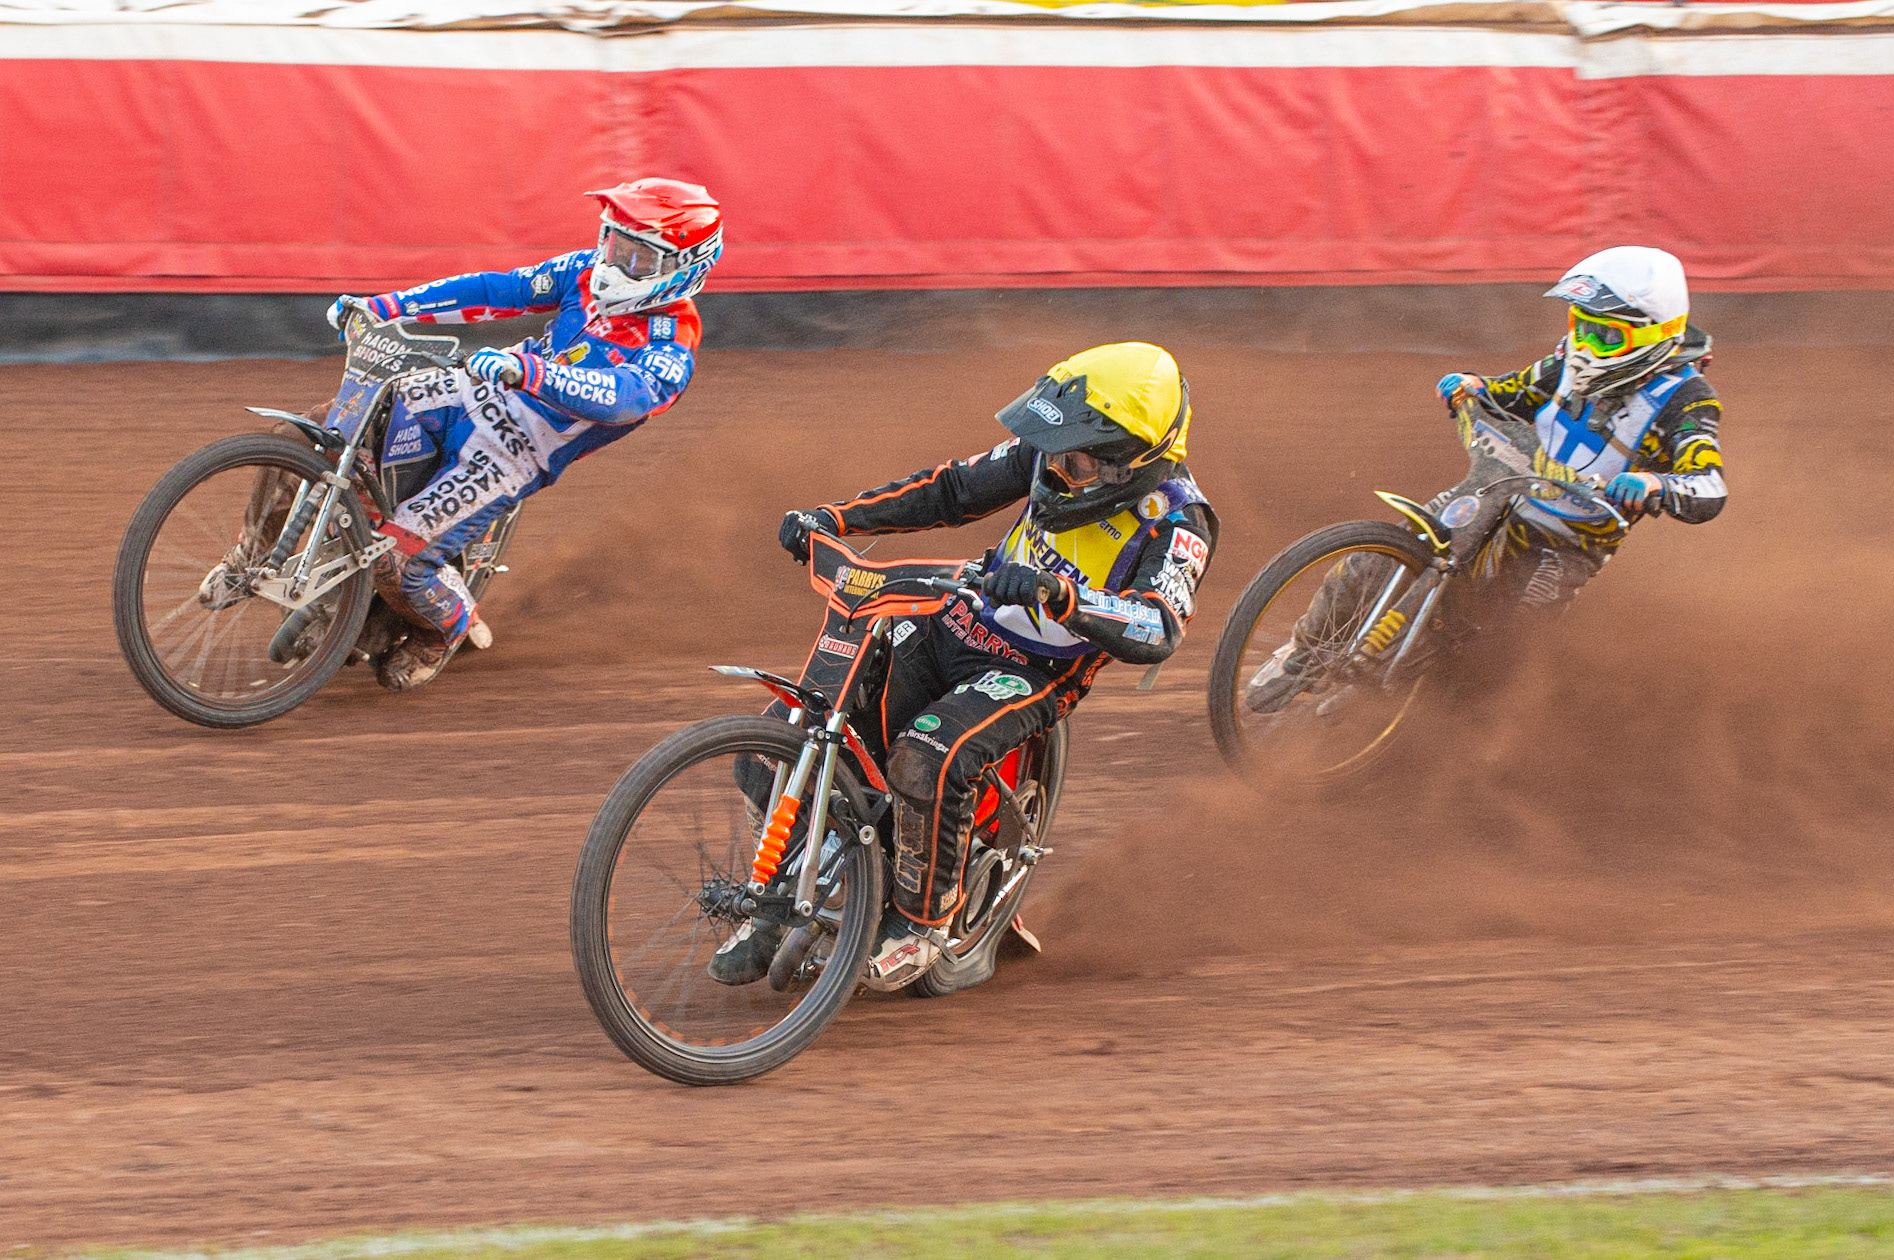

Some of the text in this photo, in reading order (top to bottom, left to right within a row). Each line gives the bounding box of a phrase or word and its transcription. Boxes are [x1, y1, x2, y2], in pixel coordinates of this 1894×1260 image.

[361, 332, 412, 360] HAGON
[545, 361, 615, 389] HAGON
[544, 373, 617, 406] SHOCKS
[473, 384, 525, 457] OCKS
[1031, 399, 1060, 423] SHOEI
[388, 439, 422, 457] SHOCKS
[394, 425, 422, 444] HAGON
[421, 462, 507, 531] HAGON
[846, 568, 886, 589] PARRYS
[949, 600, 1029, 666] PARRYS
